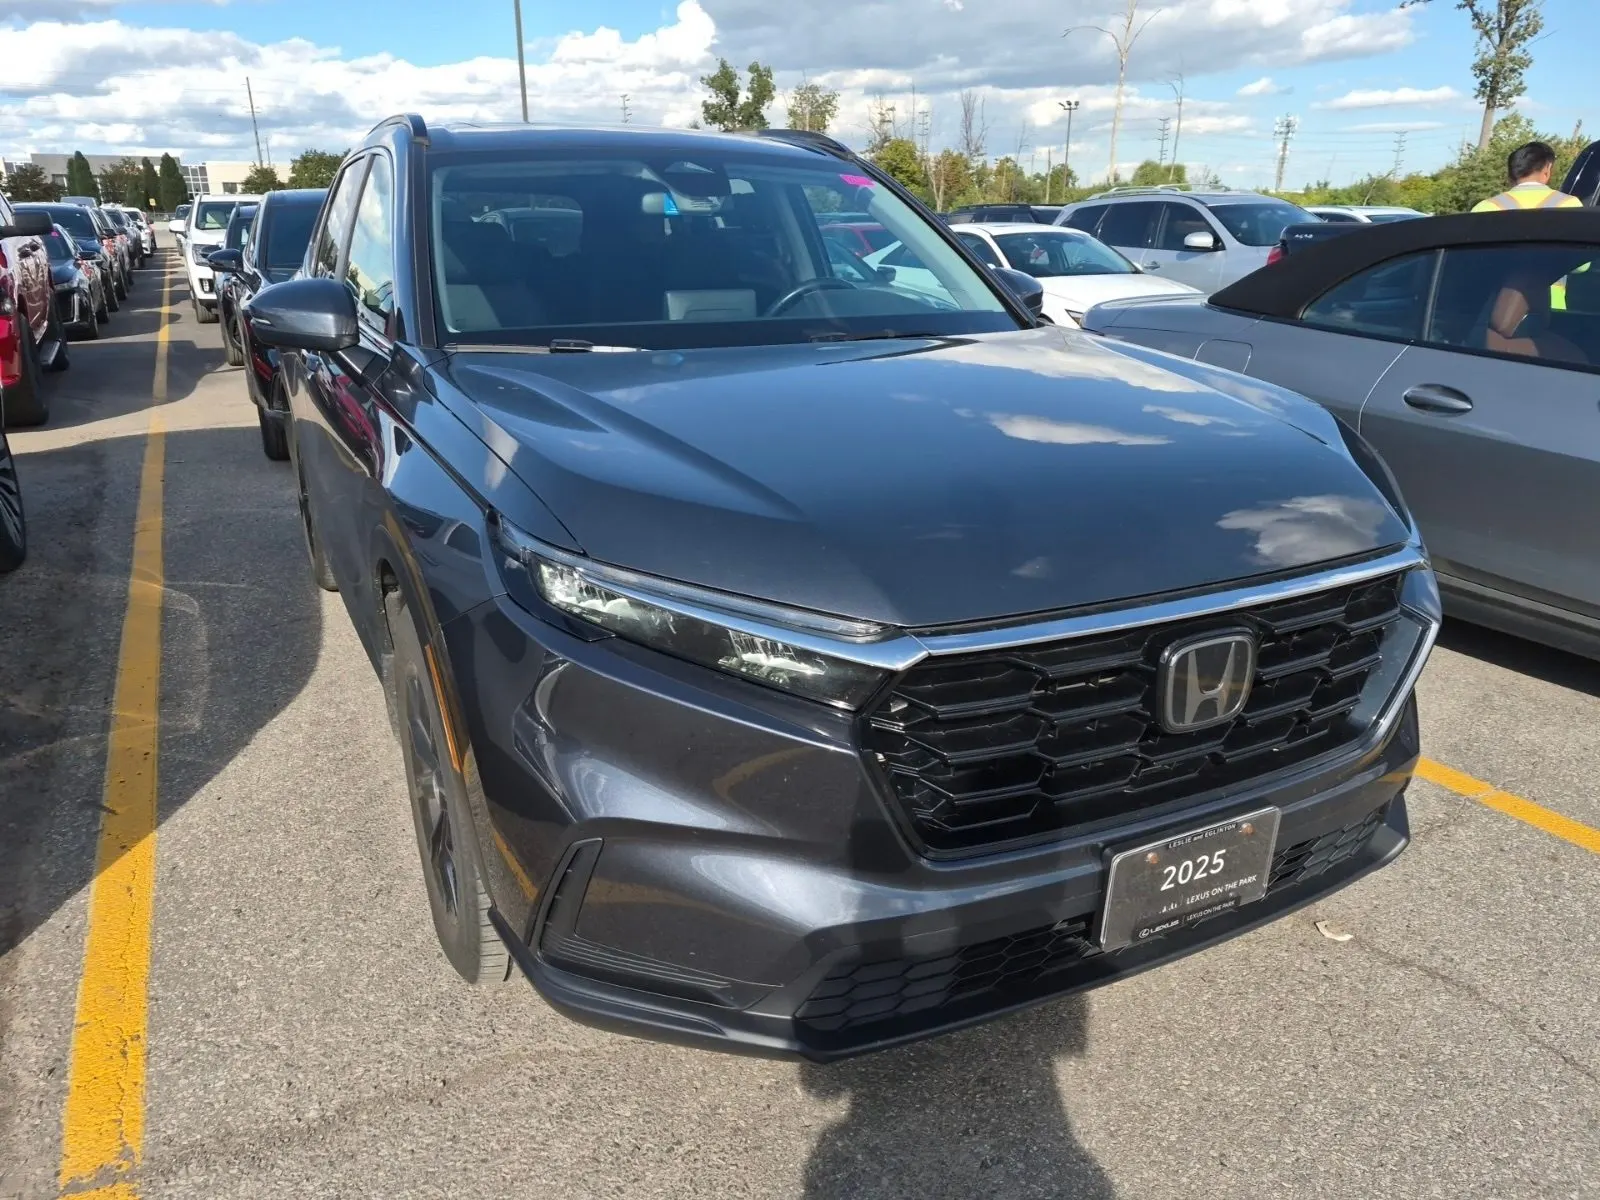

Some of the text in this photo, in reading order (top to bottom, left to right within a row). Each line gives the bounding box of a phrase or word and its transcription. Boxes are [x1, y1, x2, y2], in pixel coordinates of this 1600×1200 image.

[1168, 837, 1192, 849] LESLIE
[1204, 823, 1237, 838] EGLINTON
[1160, 849, 1227, 891] 2025
[1186, 874, 1258, 905] LEXUS ON THE PARK
[1186, 910, 1203, 921] LEXUS
